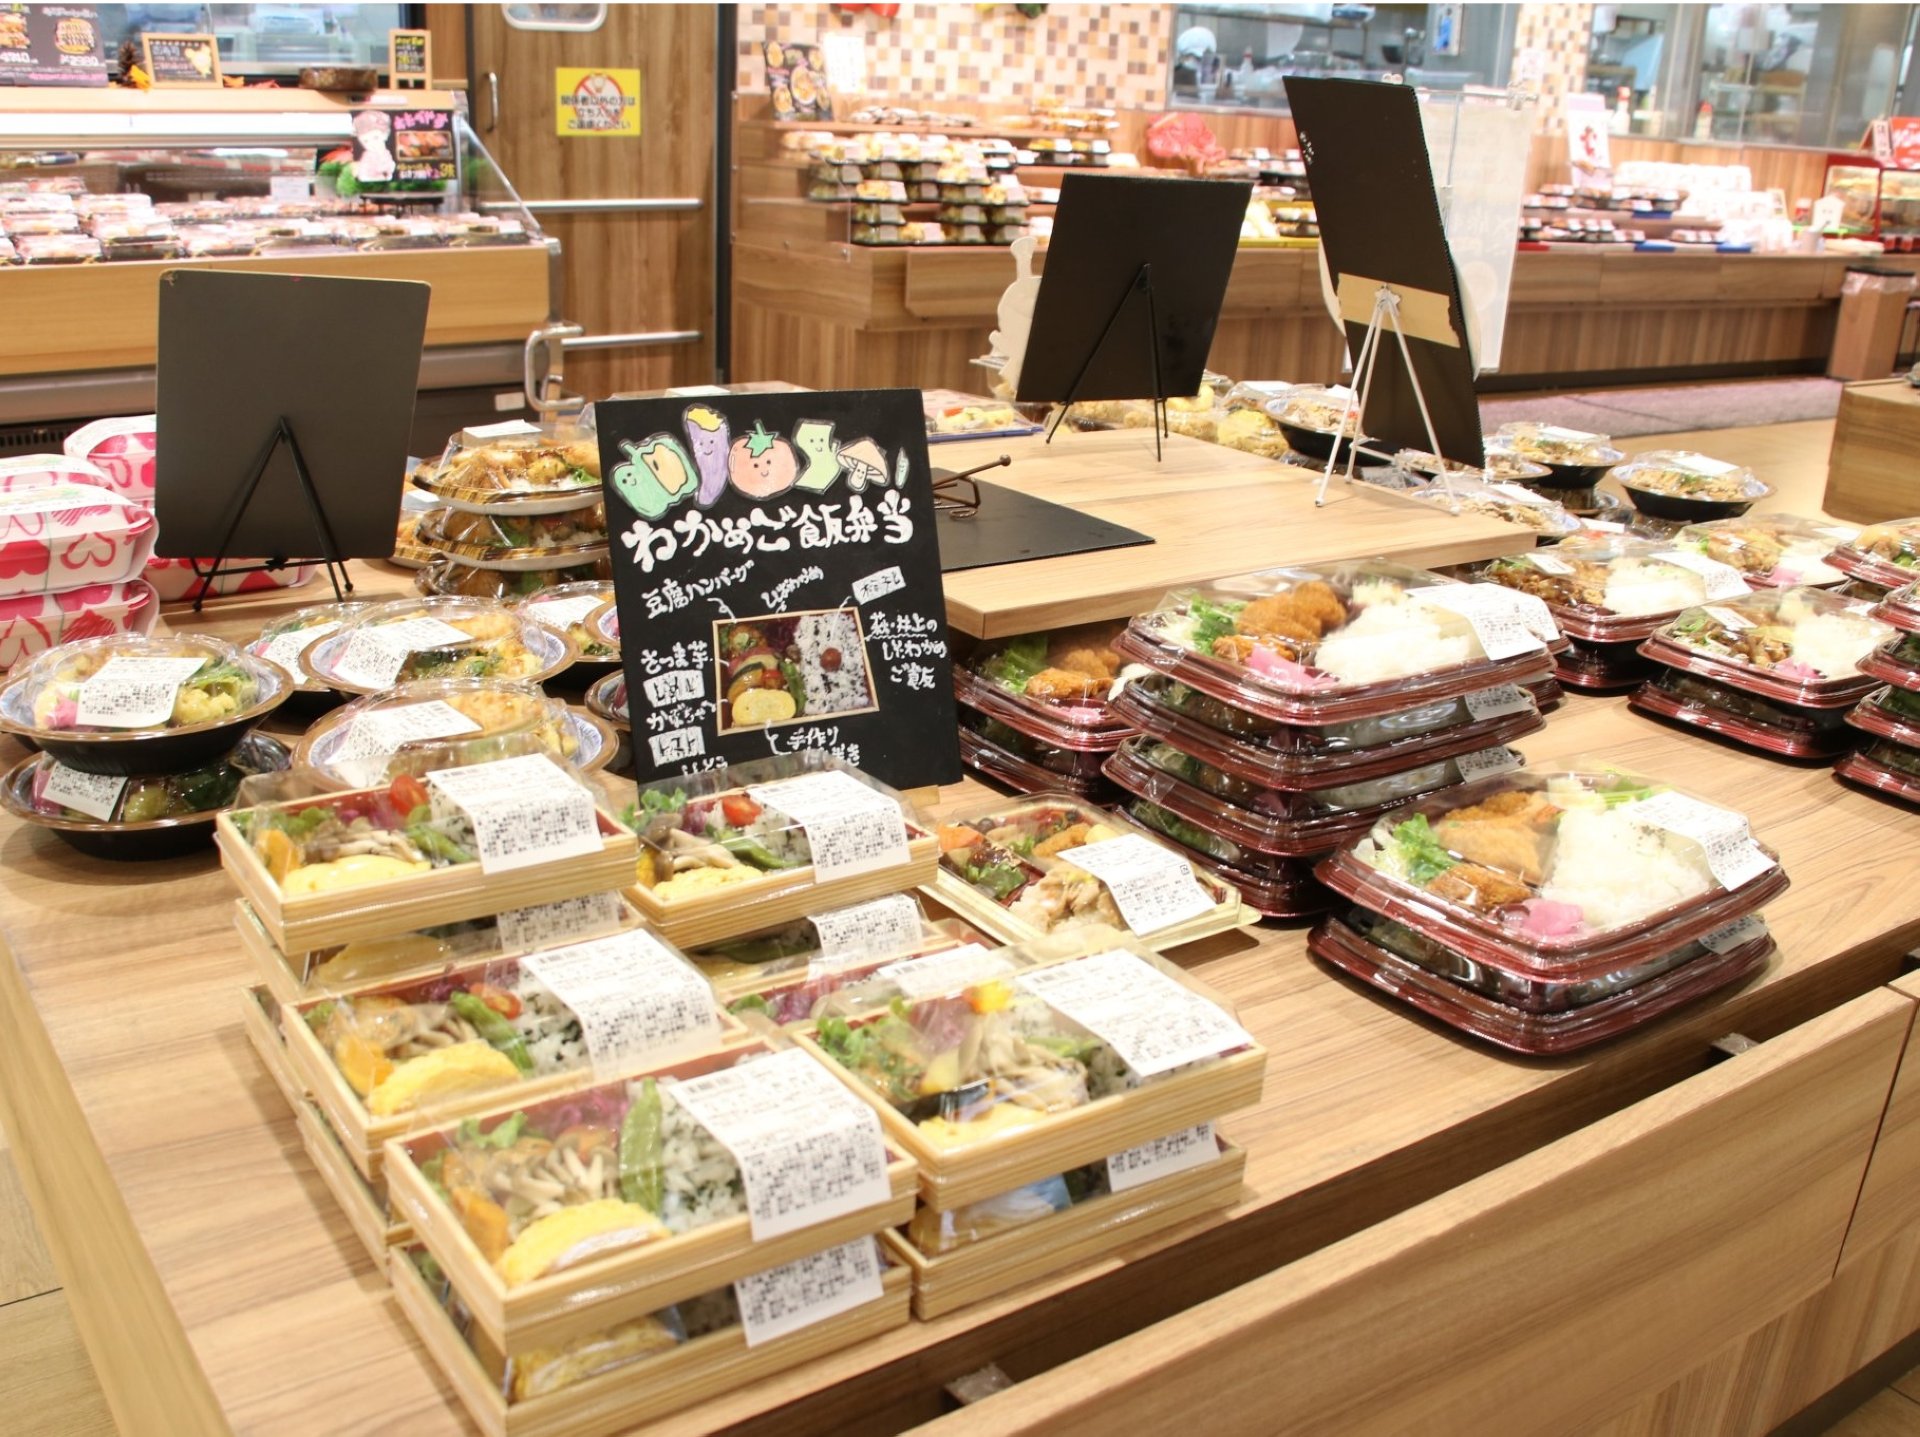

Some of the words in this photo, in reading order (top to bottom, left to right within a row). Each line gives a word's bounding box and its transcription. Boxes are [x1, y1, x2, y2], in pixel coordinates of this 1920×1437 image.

[620, 489, 914, 573] わかめご飯弁当
[641, 559, 755, 619] 豆腐ハンバーグ
[640, 640, 708, 675] さつま芋
[890, 661, 936, 691] ご飯
[786, 726, 839, 750] 手作り
